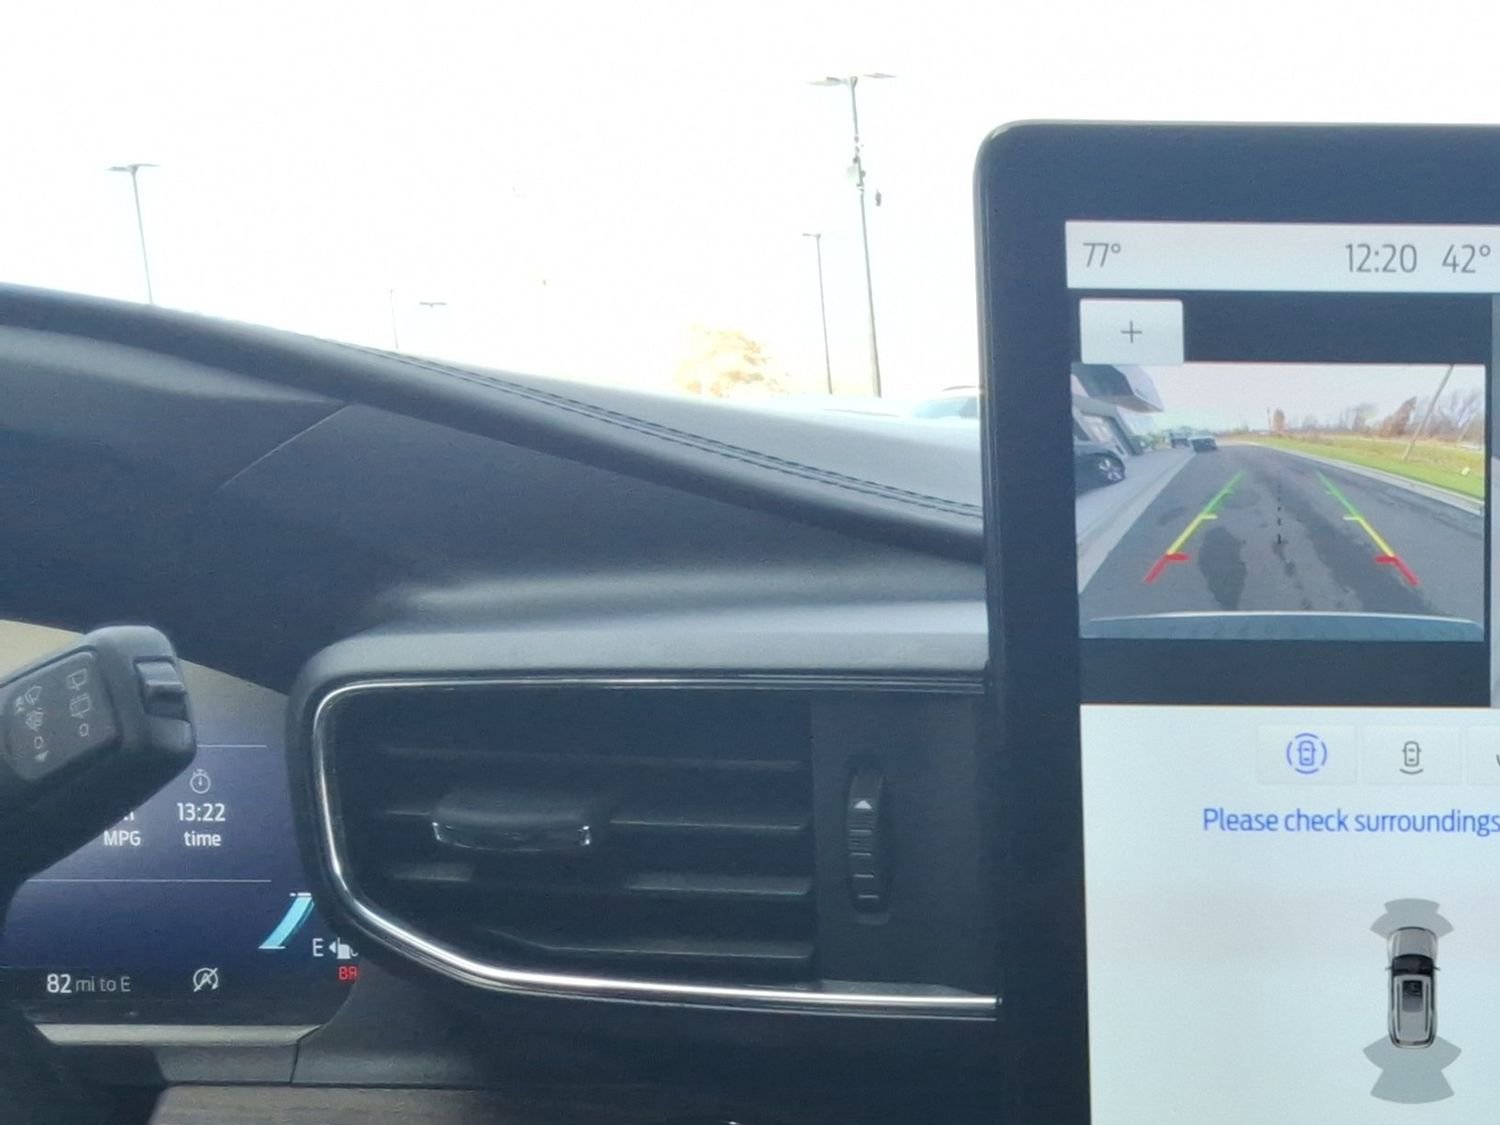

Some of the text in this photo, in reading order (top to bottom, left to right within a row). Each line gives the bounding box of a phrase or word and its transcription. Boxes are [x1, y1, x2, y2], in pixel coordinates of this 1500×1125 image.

[1345, 243, 1418, 273] 12:20
[1441, 243, 1492, 274] 42°
[176, 802, 227, 822] 13:22
[1202, 807, 1279, 832] Please
[1284, 807, 1349, 833] check
[103, 830, 142, 847] MPG
[183, 830, 222, 847] time
[312, 937, 325, 957] E
[46, 973, 132, 994] 82 mi to E
